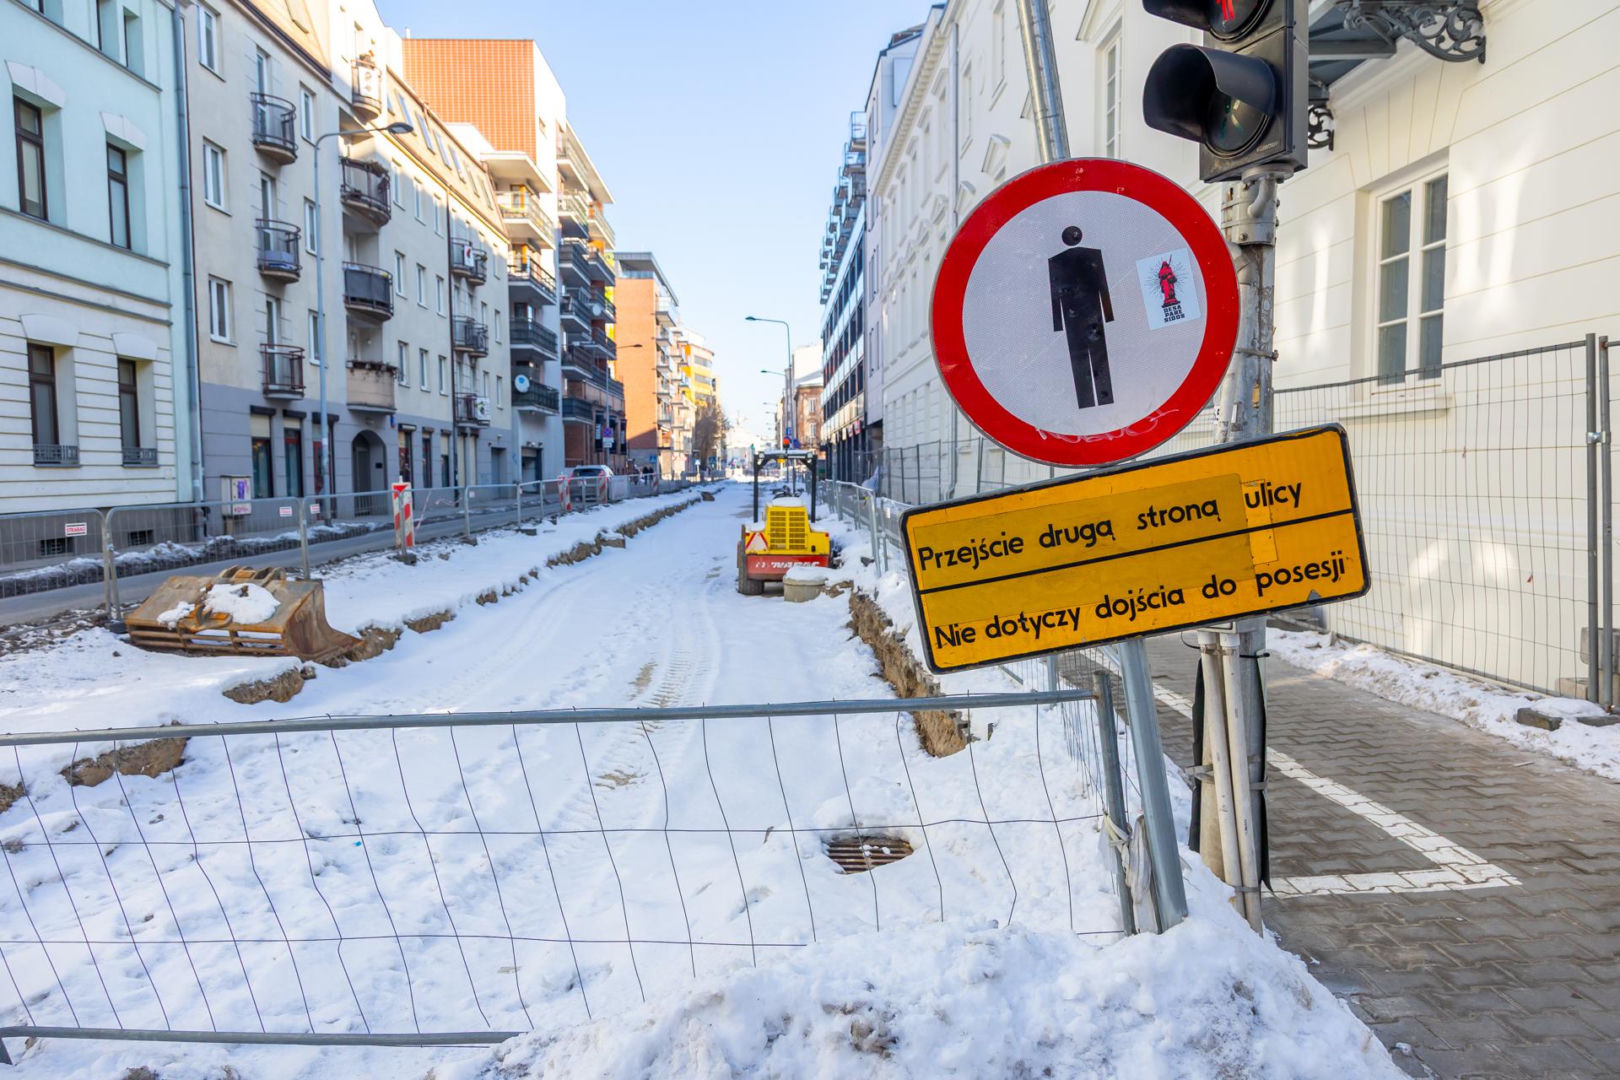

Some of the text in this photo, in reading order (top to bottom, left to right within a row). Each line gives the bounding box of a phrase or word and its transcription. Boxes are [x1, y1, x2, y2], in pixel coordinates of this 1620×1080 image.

[918, 481, 1302, 571] Przejście drugą stroną ulicy
[934, 550, 1346, 649] Nie dotyczy dojścia do posesji
